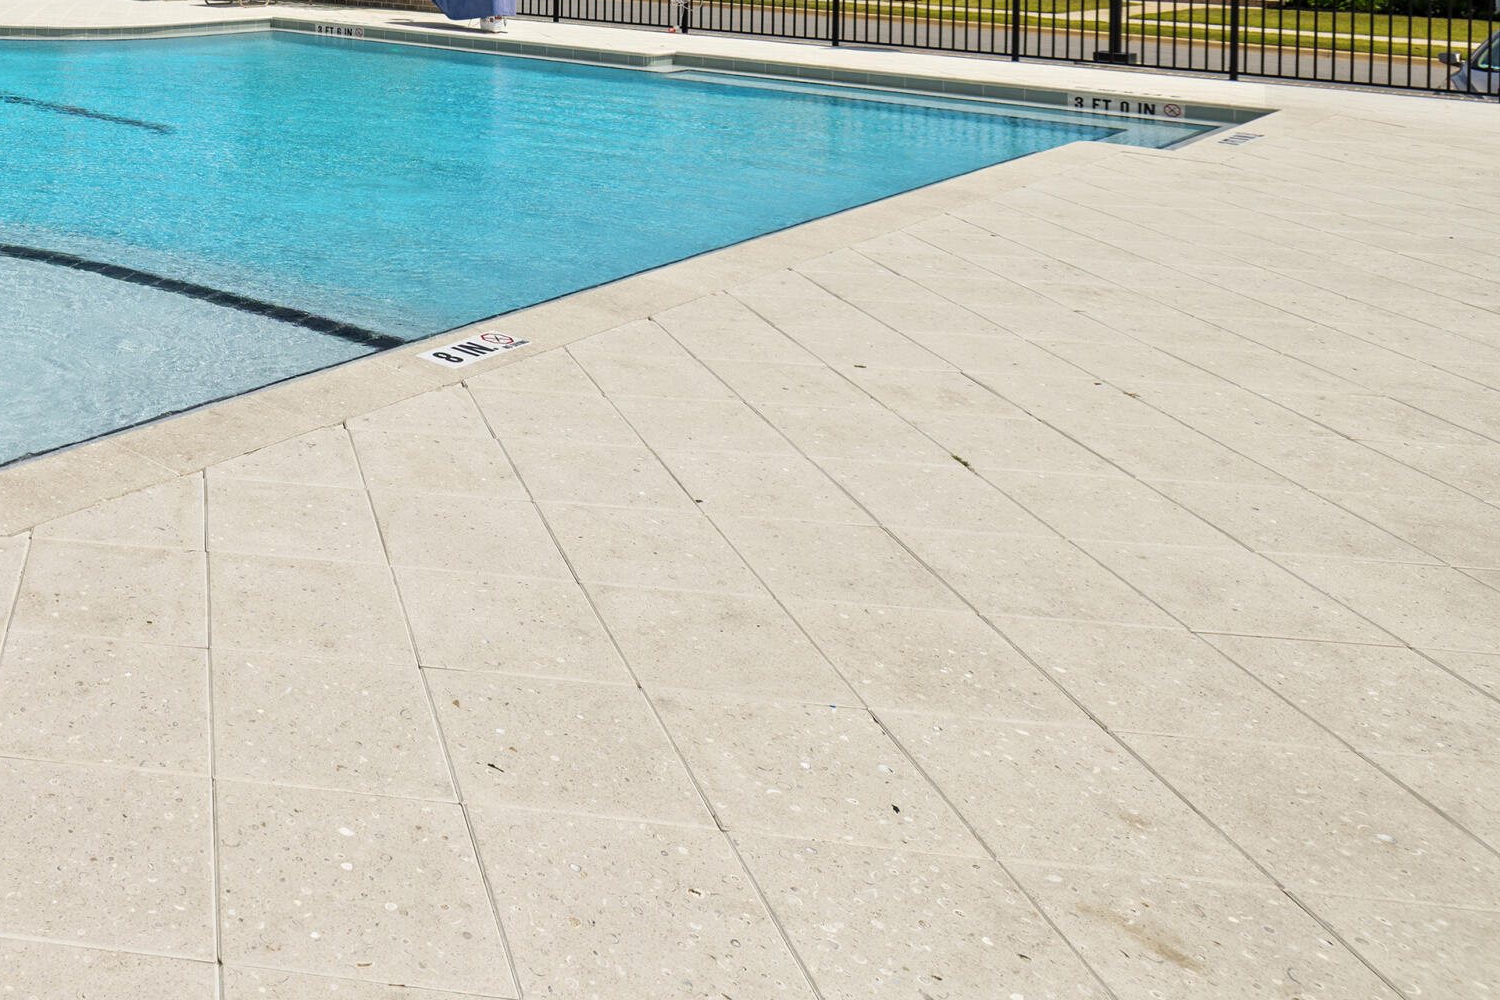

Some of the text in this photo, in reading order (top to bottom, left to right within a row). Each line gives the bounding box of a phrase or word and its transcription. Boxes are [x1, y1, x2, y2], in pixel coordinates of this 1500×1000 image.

[325, 26, 334, 35] FT
[344, 28, 352, 36] IN
[1074, 96, 1084, 108] 3
[1092, 98, 1112, 110] FT
[1138, 102, 1156, 115] IN
[432, 341, 499, 363] 8 IN.
